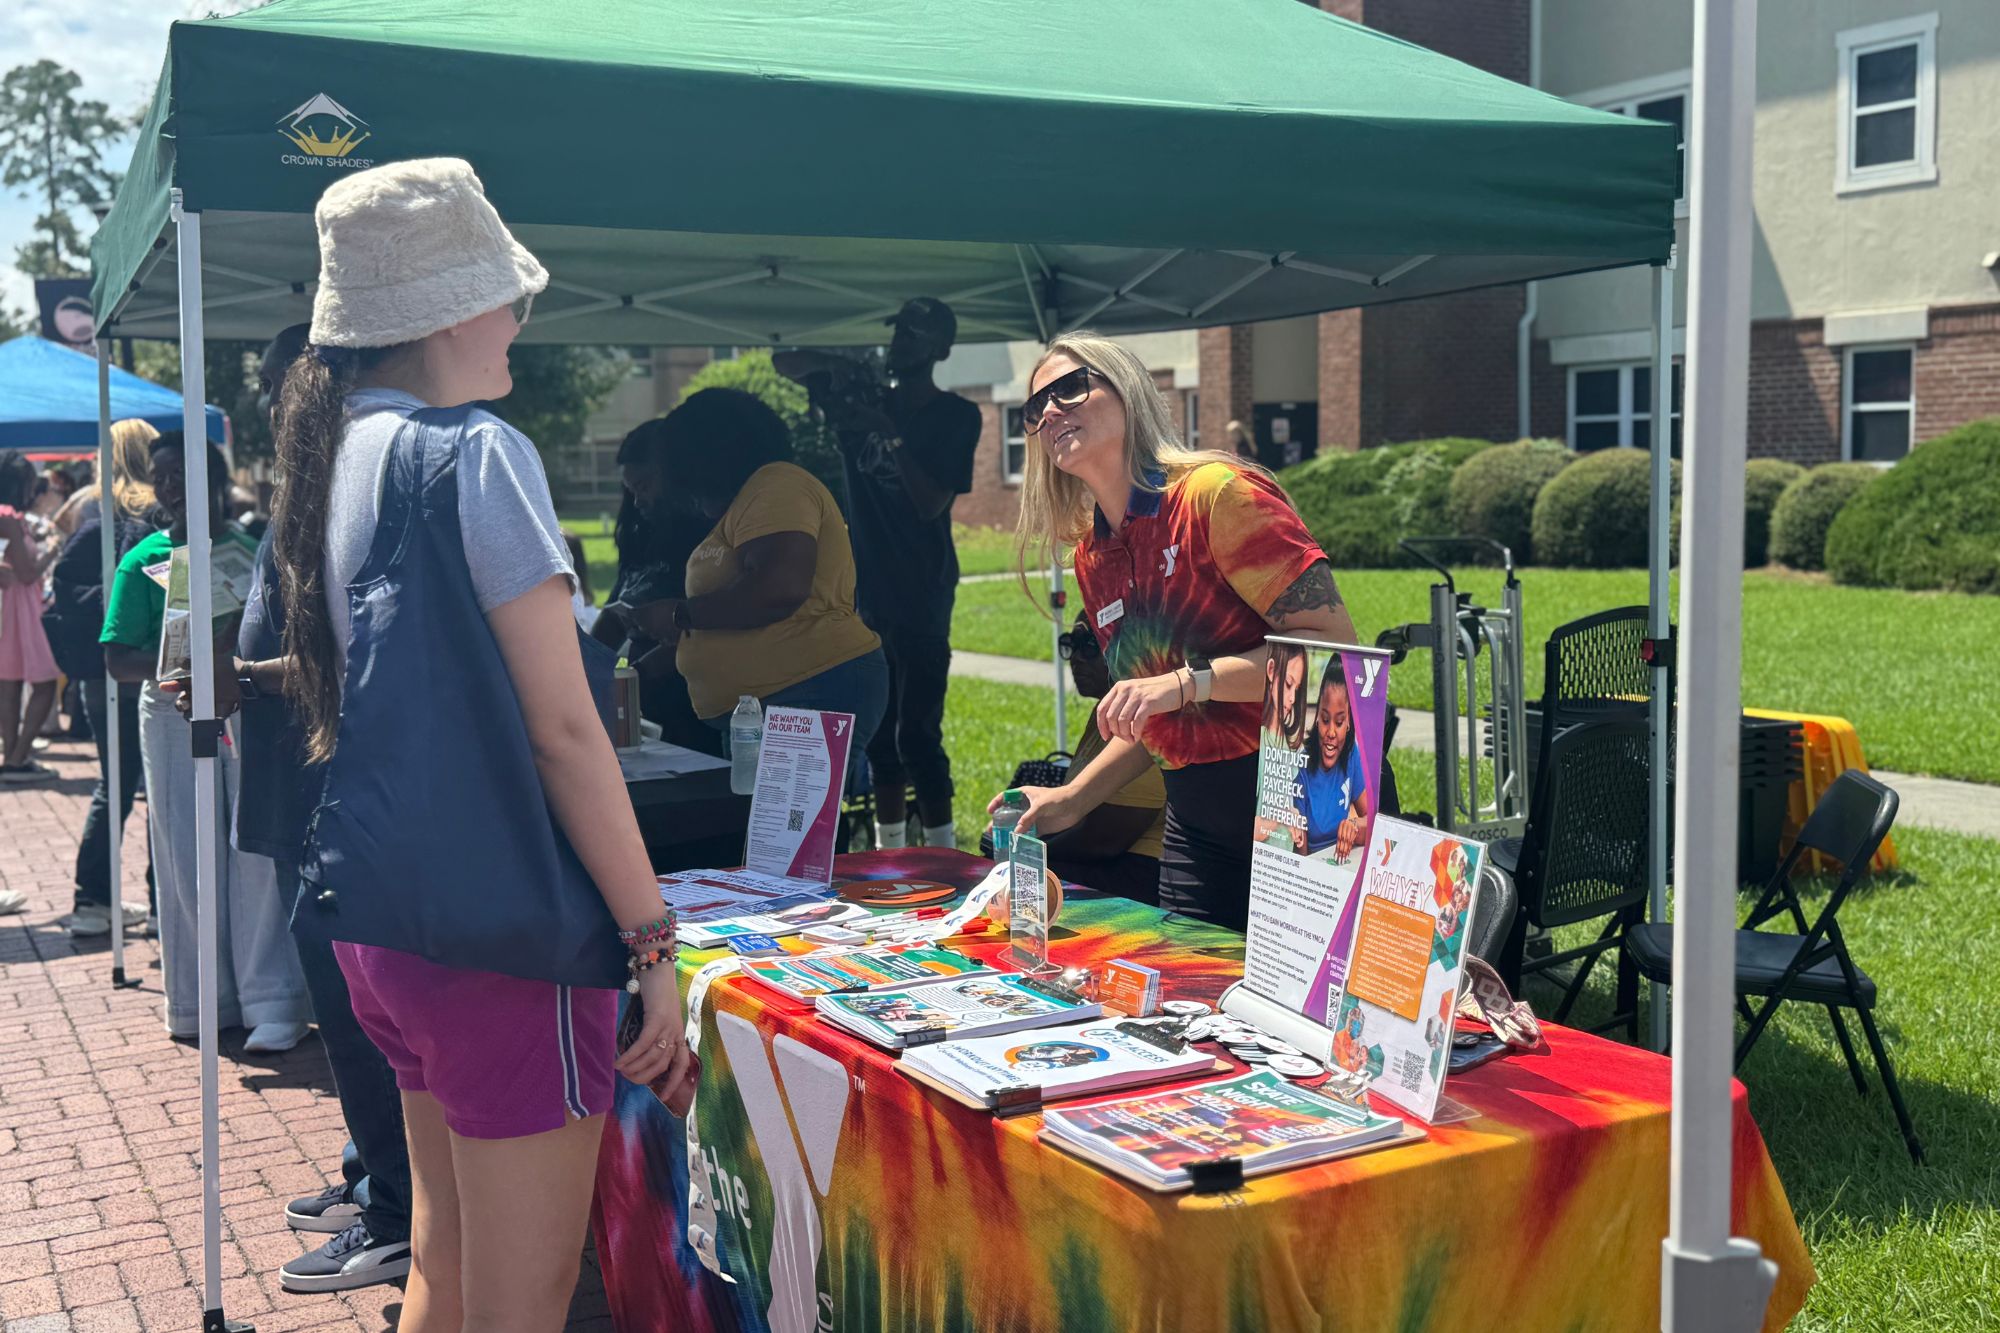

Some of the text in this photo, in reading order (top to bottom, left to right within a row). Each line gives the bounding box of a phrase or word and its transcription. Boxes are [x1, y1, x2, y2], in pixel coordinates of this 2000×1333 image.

[281, 155, 323, 167] CROWN
[768, 722, 811, 734] ON OUR TEAM
[769, 713, 813, 726] WE WANT YOU
[1265, 746, 1309, 768] DON'T JUST
[1263, 761, 1293, 780] MAKE A
[1263, 776, 1304, 798] PAYCHECK.
[1262, 790, 1290, 810] MAKE A
[1260, 805, 1308, 831] DIFFERENCE.
[1471, 827, 1508, 841] COSCO
[1370, 867, 1414, 905] WHY
[1124, 1046, 1169, 1062] ACCESS
[1191, 1092, 1240, 1112] 2025
[1215, 1087, 1280, 1110] NIGHT
[1243, 1081, 1305, 1106] SKATE
